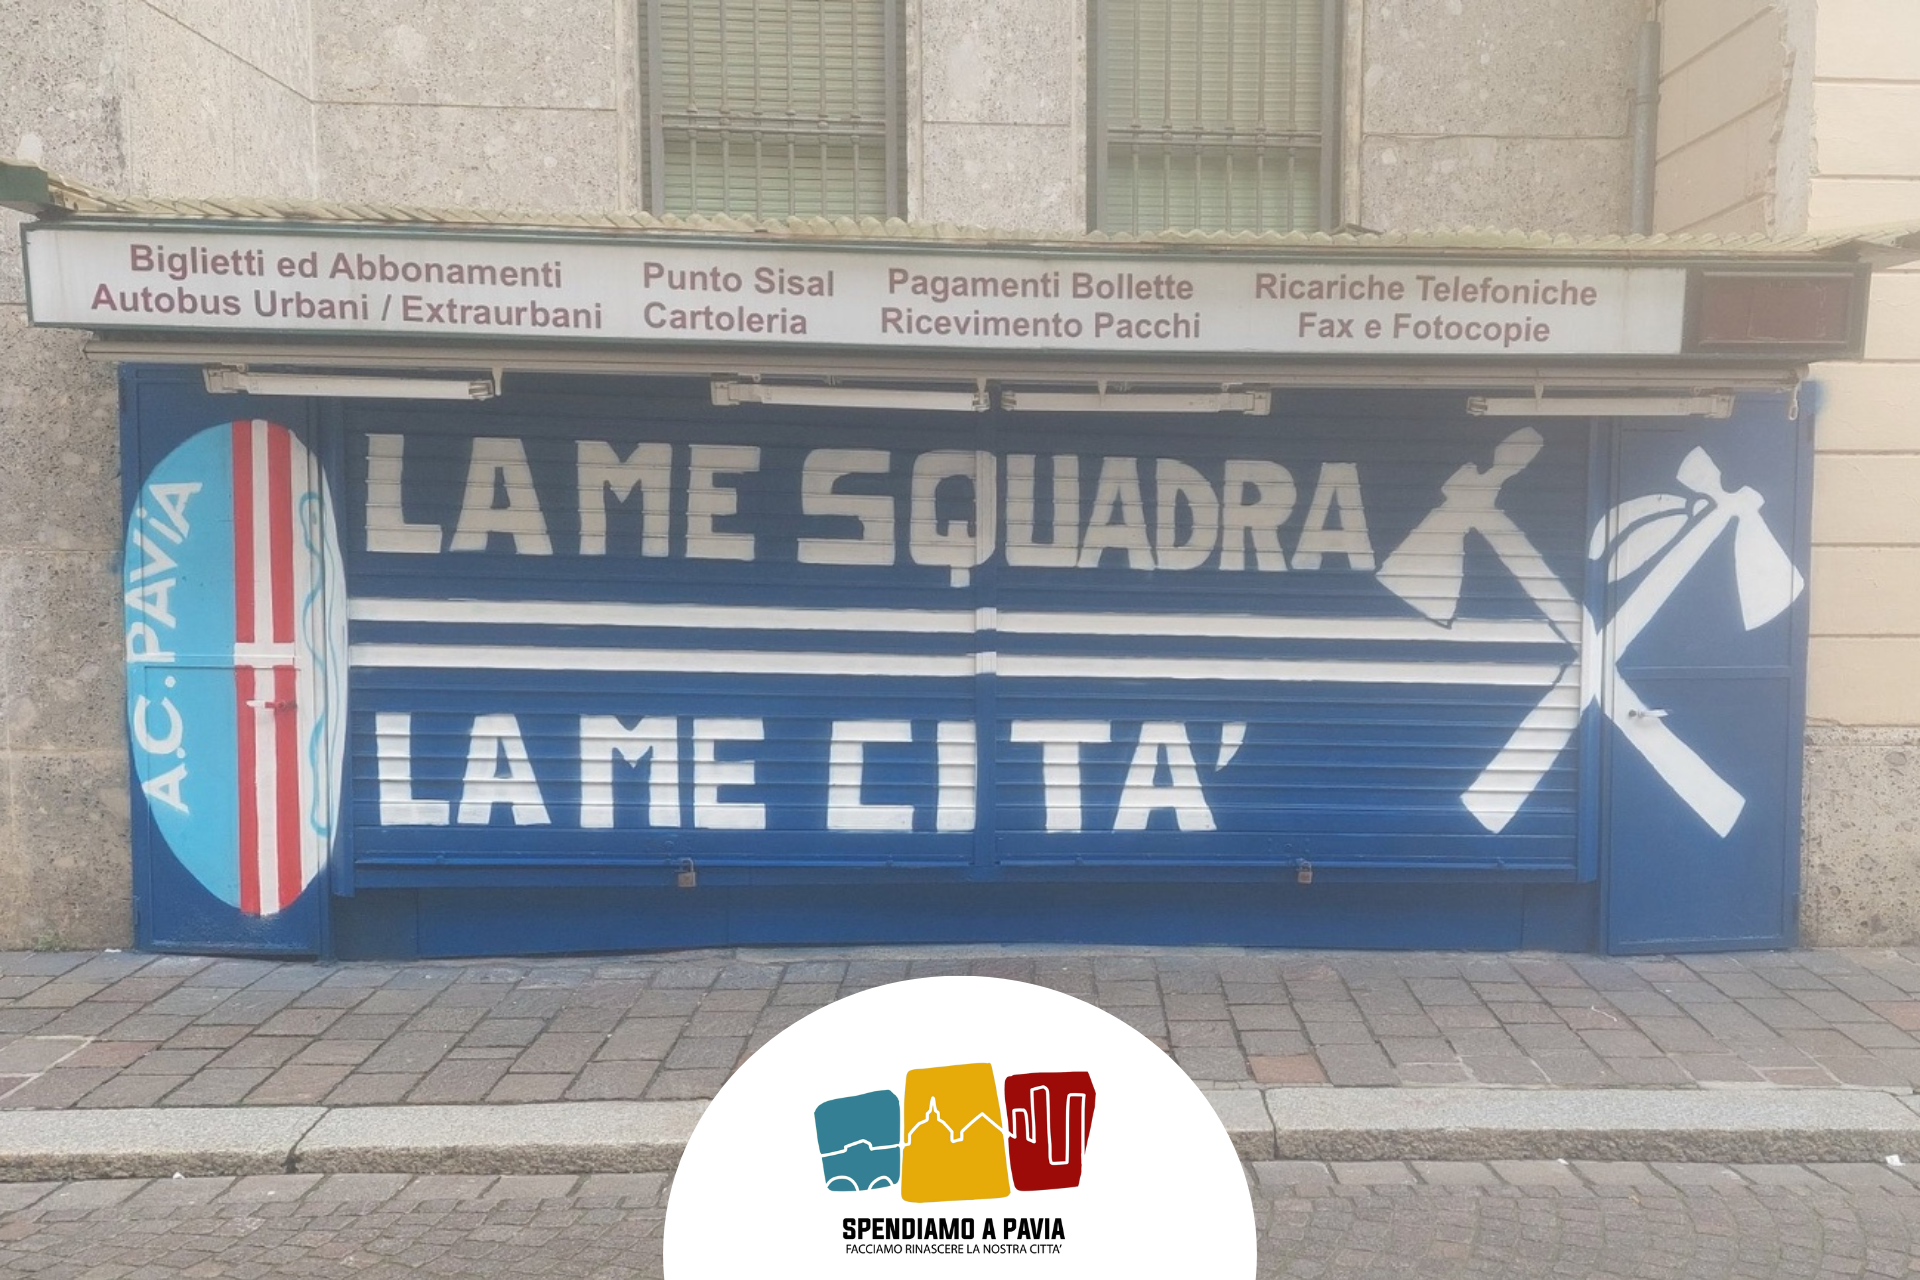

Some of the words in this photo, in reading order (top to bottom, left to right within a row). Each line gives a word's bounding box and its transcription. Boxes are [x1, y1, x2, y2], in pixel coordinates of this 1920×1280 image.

[130, 244, 264, 279] Biglietti
[277, 251, 318, 279] ed
[329, 252, 562, 288] Abbonamenti
[643, 262, 742, 292] Punto
[754, 267, 834, 297] Sisal
[888, 268, 1060, 302] Pagamenti
[1072, 272, 1193, 300] Bollette
[1255, 273, 1405, 301] Ricariche
[1416, 274, 1598, 306] Telefoniche
[91, 284, 241, 316] Autobus
[254, 290, 369, 320] Urbani
[381, 294, 391, 322] /
[403, 295, 602, 330] Extraurbani
[643, 301, 807, 335] Cartoleria
[881, 307, 1082, 338] Ricevimento
[1094, 312, 1201, 339] Pacchi
[1298, 313, 1354, 339] Fax
[1364, 318, 1382, 339] e
[1393, 313, 1550, 347] Fotocopie
[366, 433, 553, 556] LA
[576, 440, 760, 561] ME
[797, 448, 1376, 588] SQUADRA
[375, 711, 552, 826] LA
[579, 714, 766, 830] ME
